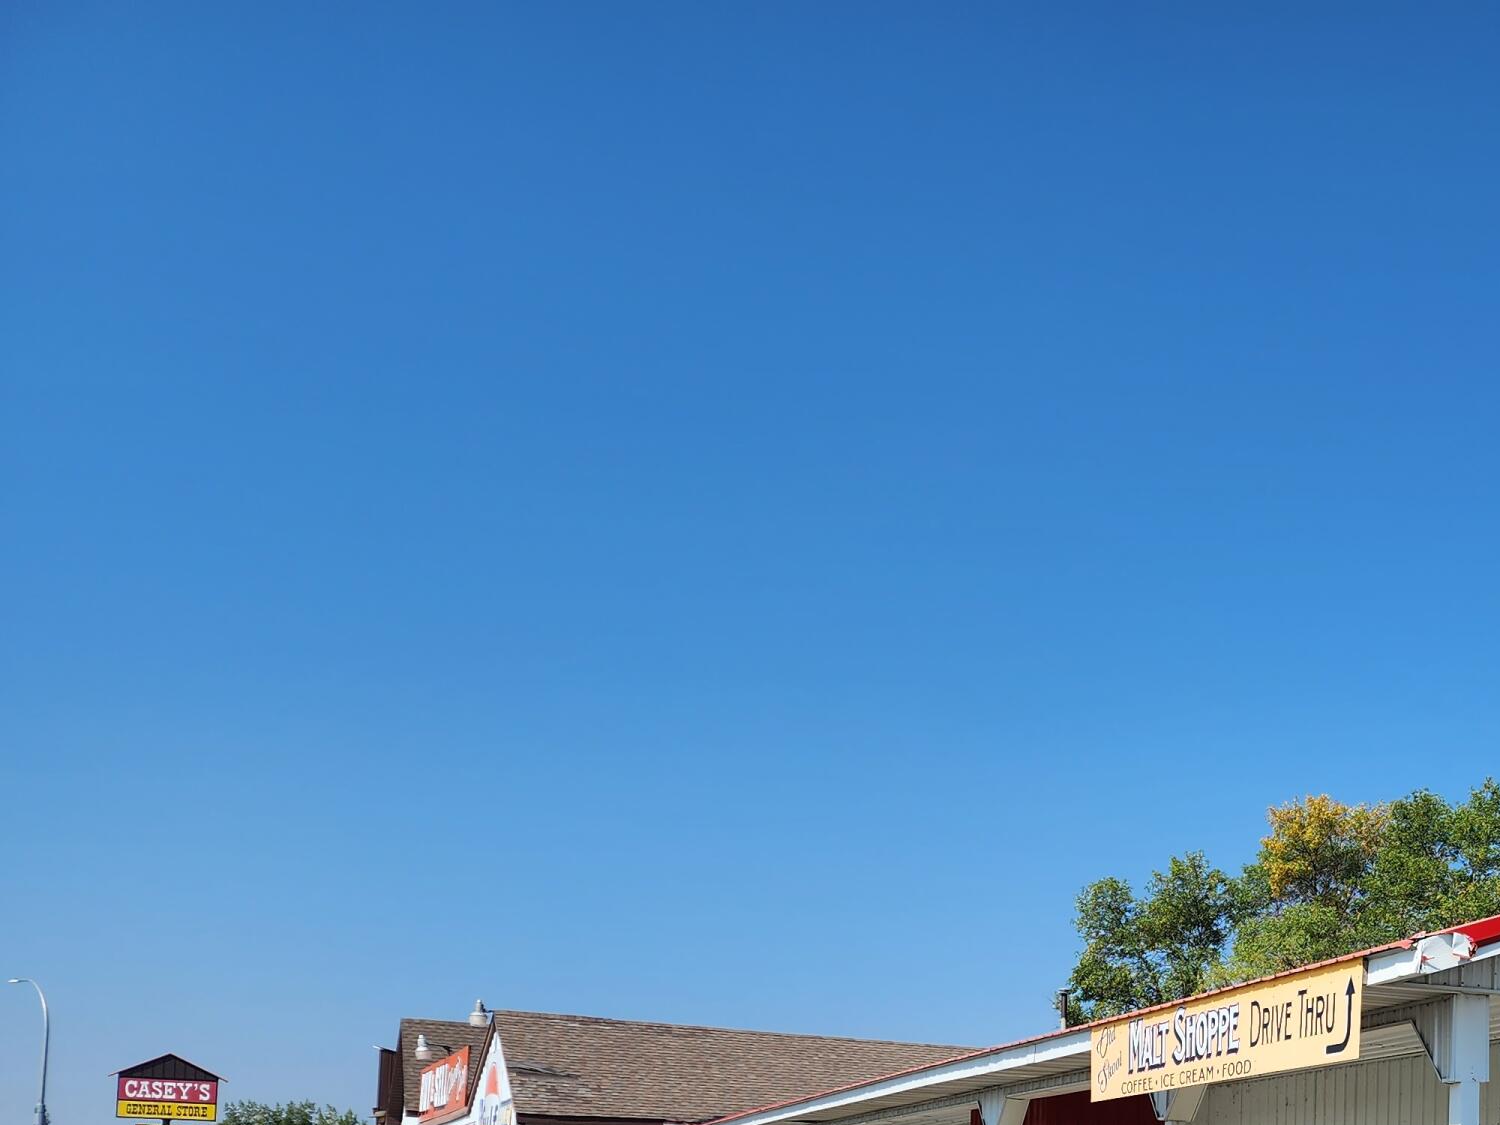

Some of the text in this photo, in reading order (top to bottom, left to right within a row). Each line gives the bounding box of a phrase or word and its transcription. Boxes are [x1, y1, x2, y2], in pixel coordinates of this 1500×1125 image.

[1097, 1024, 1117, 1059] Old
[1128, 989, 1336, 1074] MALT SHOPPE DRIVE THRU
[124, 1080, 211, 1101] CASEY'S
[1121, 1059, 1252, 1095] COFFEE ICE CREAM FOOD
[126, 1103, 208, 1118] GENERAL STORE
